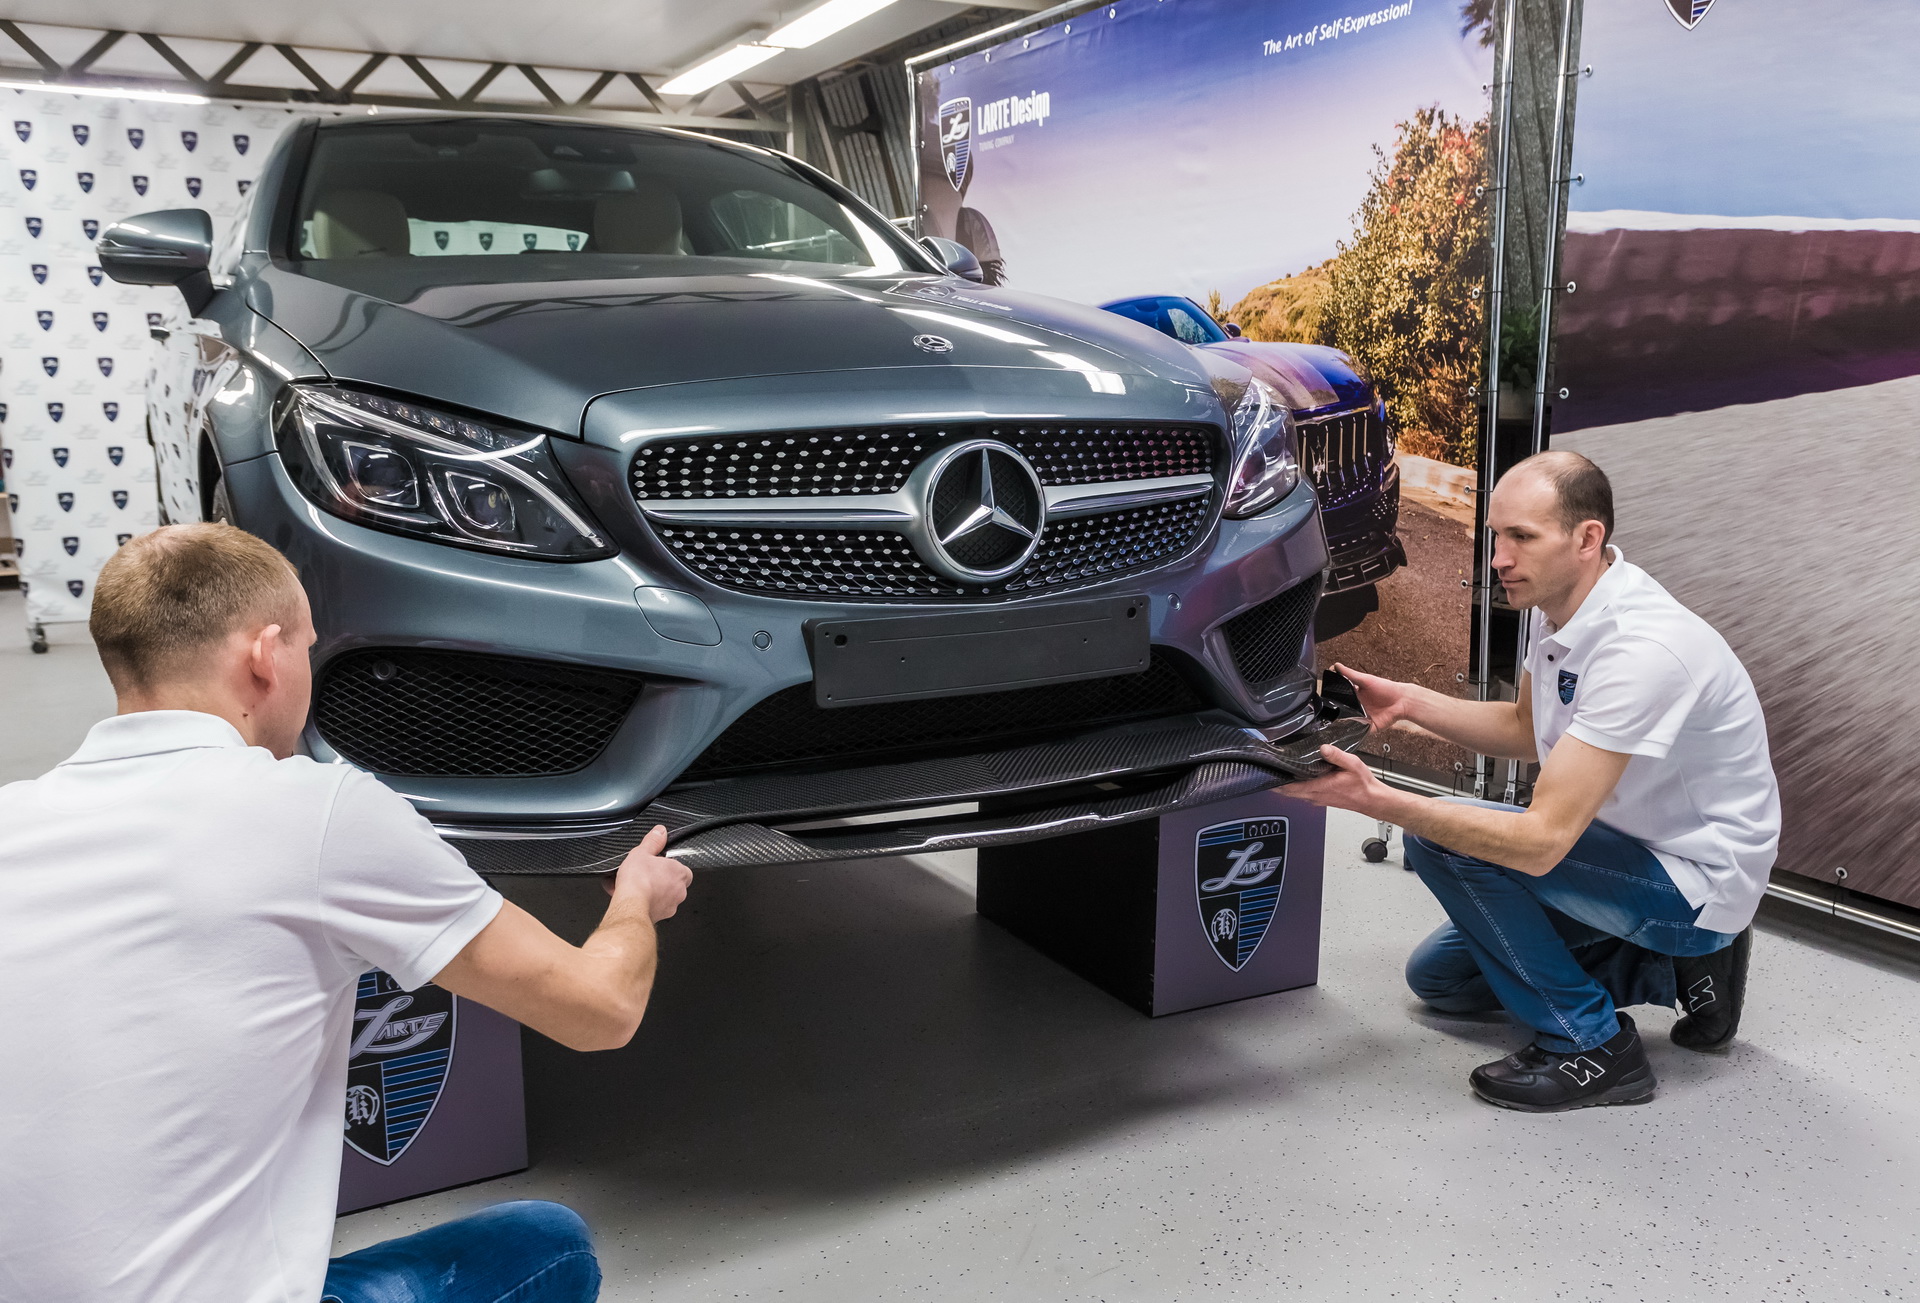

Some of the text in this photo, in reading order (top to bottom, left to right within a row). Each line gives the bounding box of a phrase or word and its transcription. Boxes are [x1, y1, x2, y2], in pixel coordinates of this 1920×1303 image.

[1263, 0, 1413, 56] The Art of Self-Expression!
[977, 98, 1010, 135] LARTE
[1010, 90, 1050, 127] Design
[1200, 841, 1283, 893] LARTE
